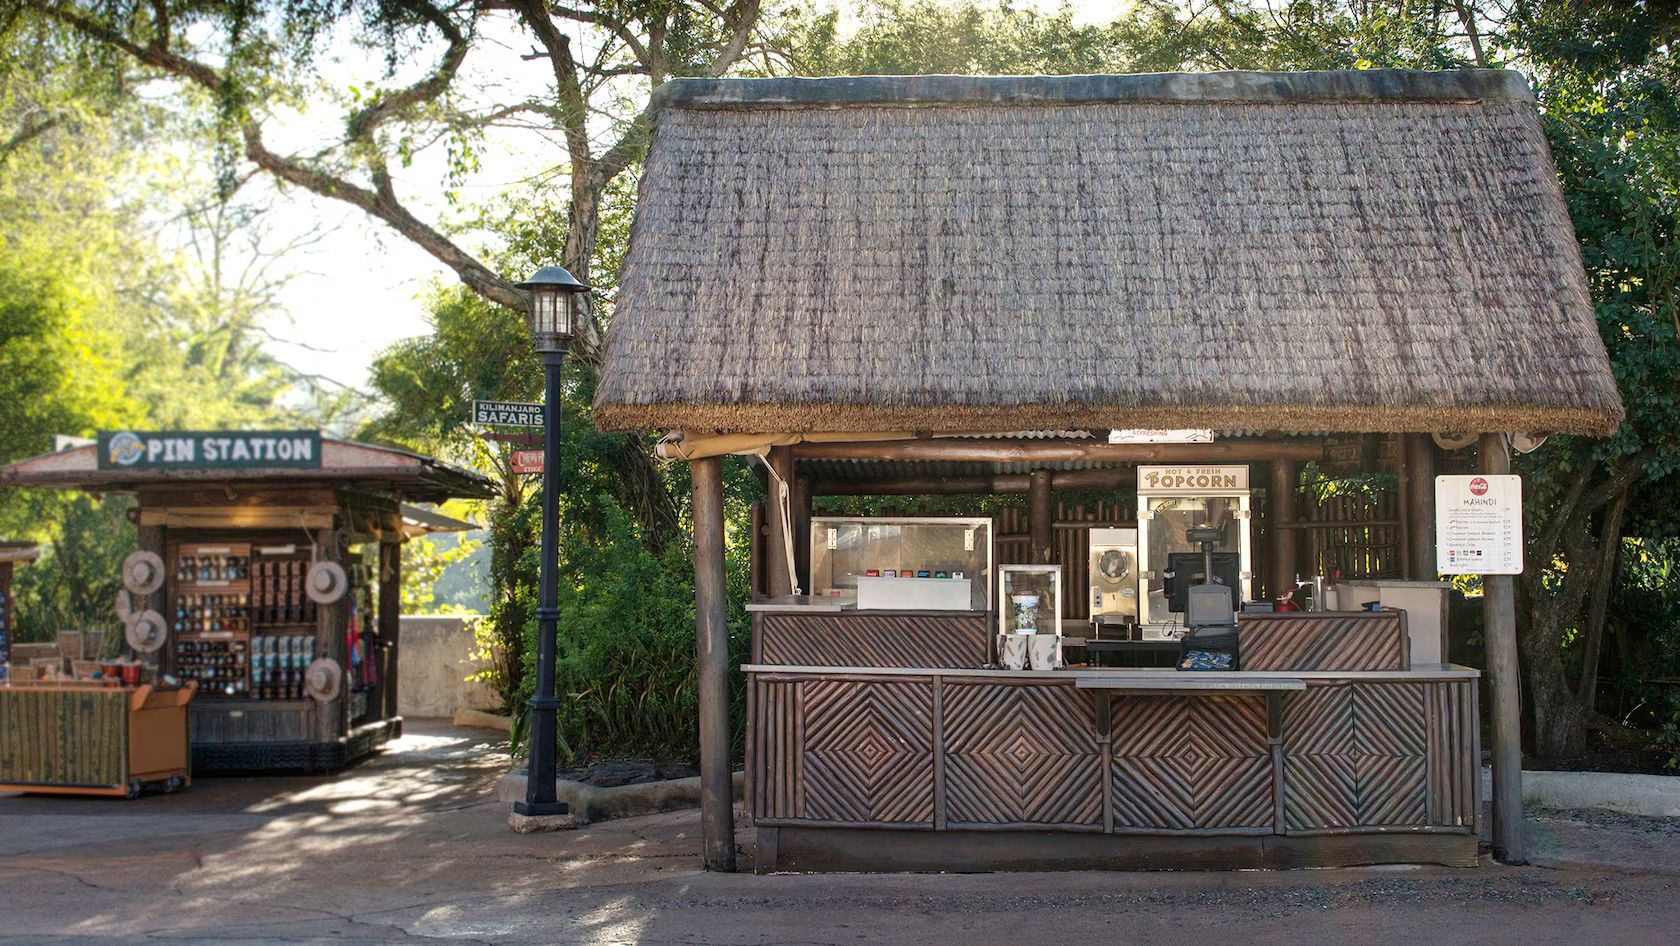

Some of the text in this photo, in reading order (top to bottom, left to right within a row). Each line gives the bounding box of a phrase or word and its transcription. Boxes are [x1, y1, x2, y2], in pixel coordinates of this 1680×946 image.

[479, 403, 541, 413] KILIMANJARO
[478, 411, 544, 425] SAFARIS
[147, 437, 312, 462] PIN STATION
[1150, 475, 1236, 487] POPCORN
[1463, 498, 1497, 506] MAHINDI
